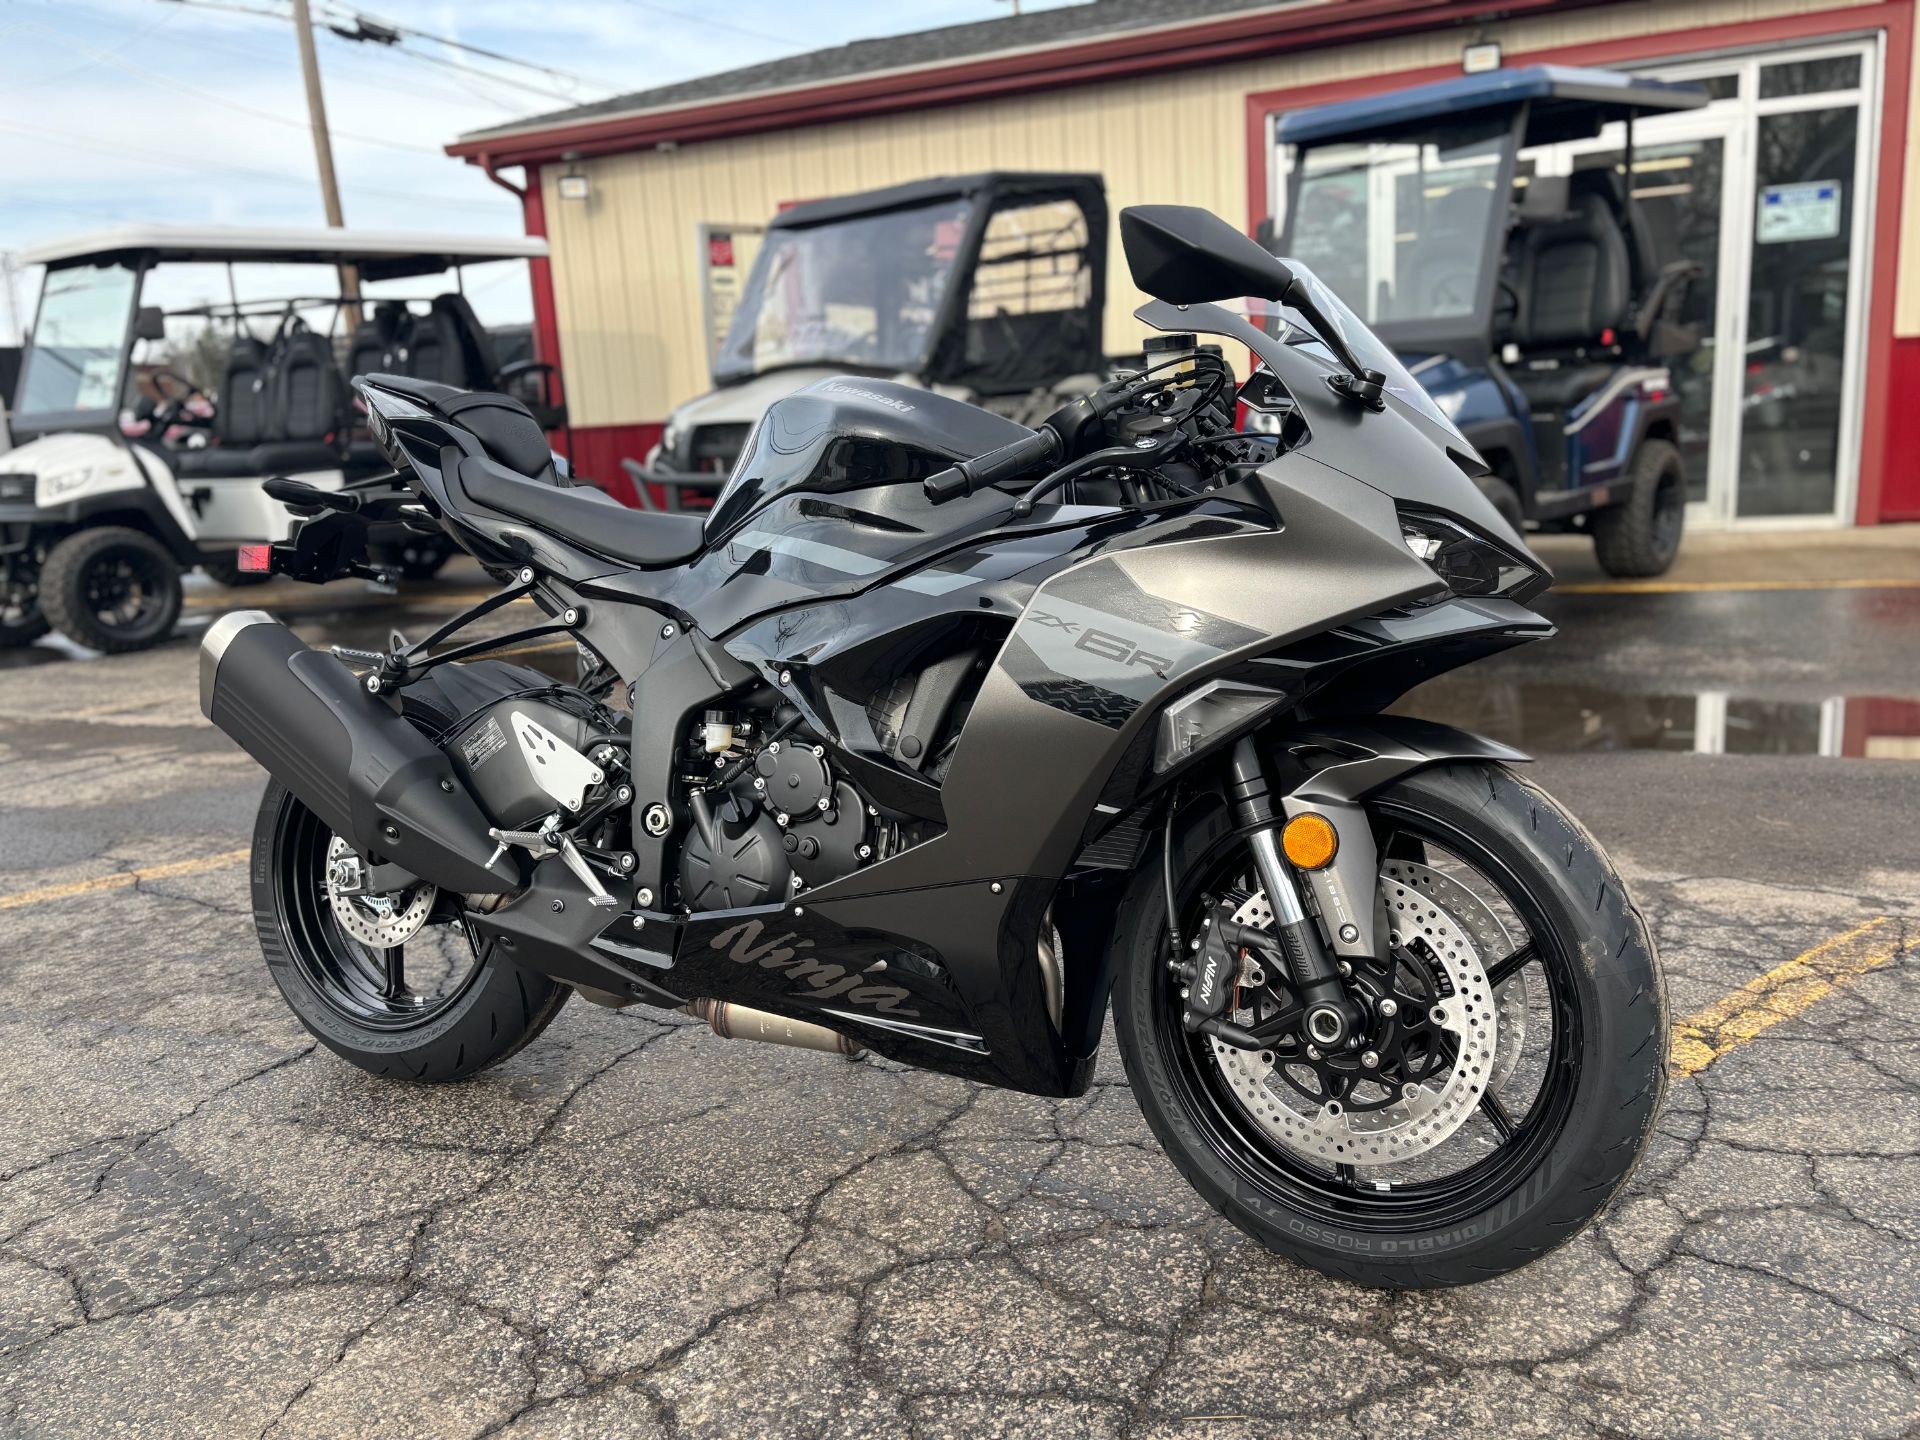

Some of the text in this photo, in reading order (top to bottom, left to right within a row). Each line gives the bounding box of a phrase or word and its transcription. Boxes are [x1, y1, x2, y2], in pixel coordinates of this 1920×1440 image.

[822, 382, 916, 412] Kawasaki
[710, 919, 921, 1017] Ninja
[1289, 1219, 1372, 1250] ROSSO
[1381, 1224, 1479, 1252] DIABLO
